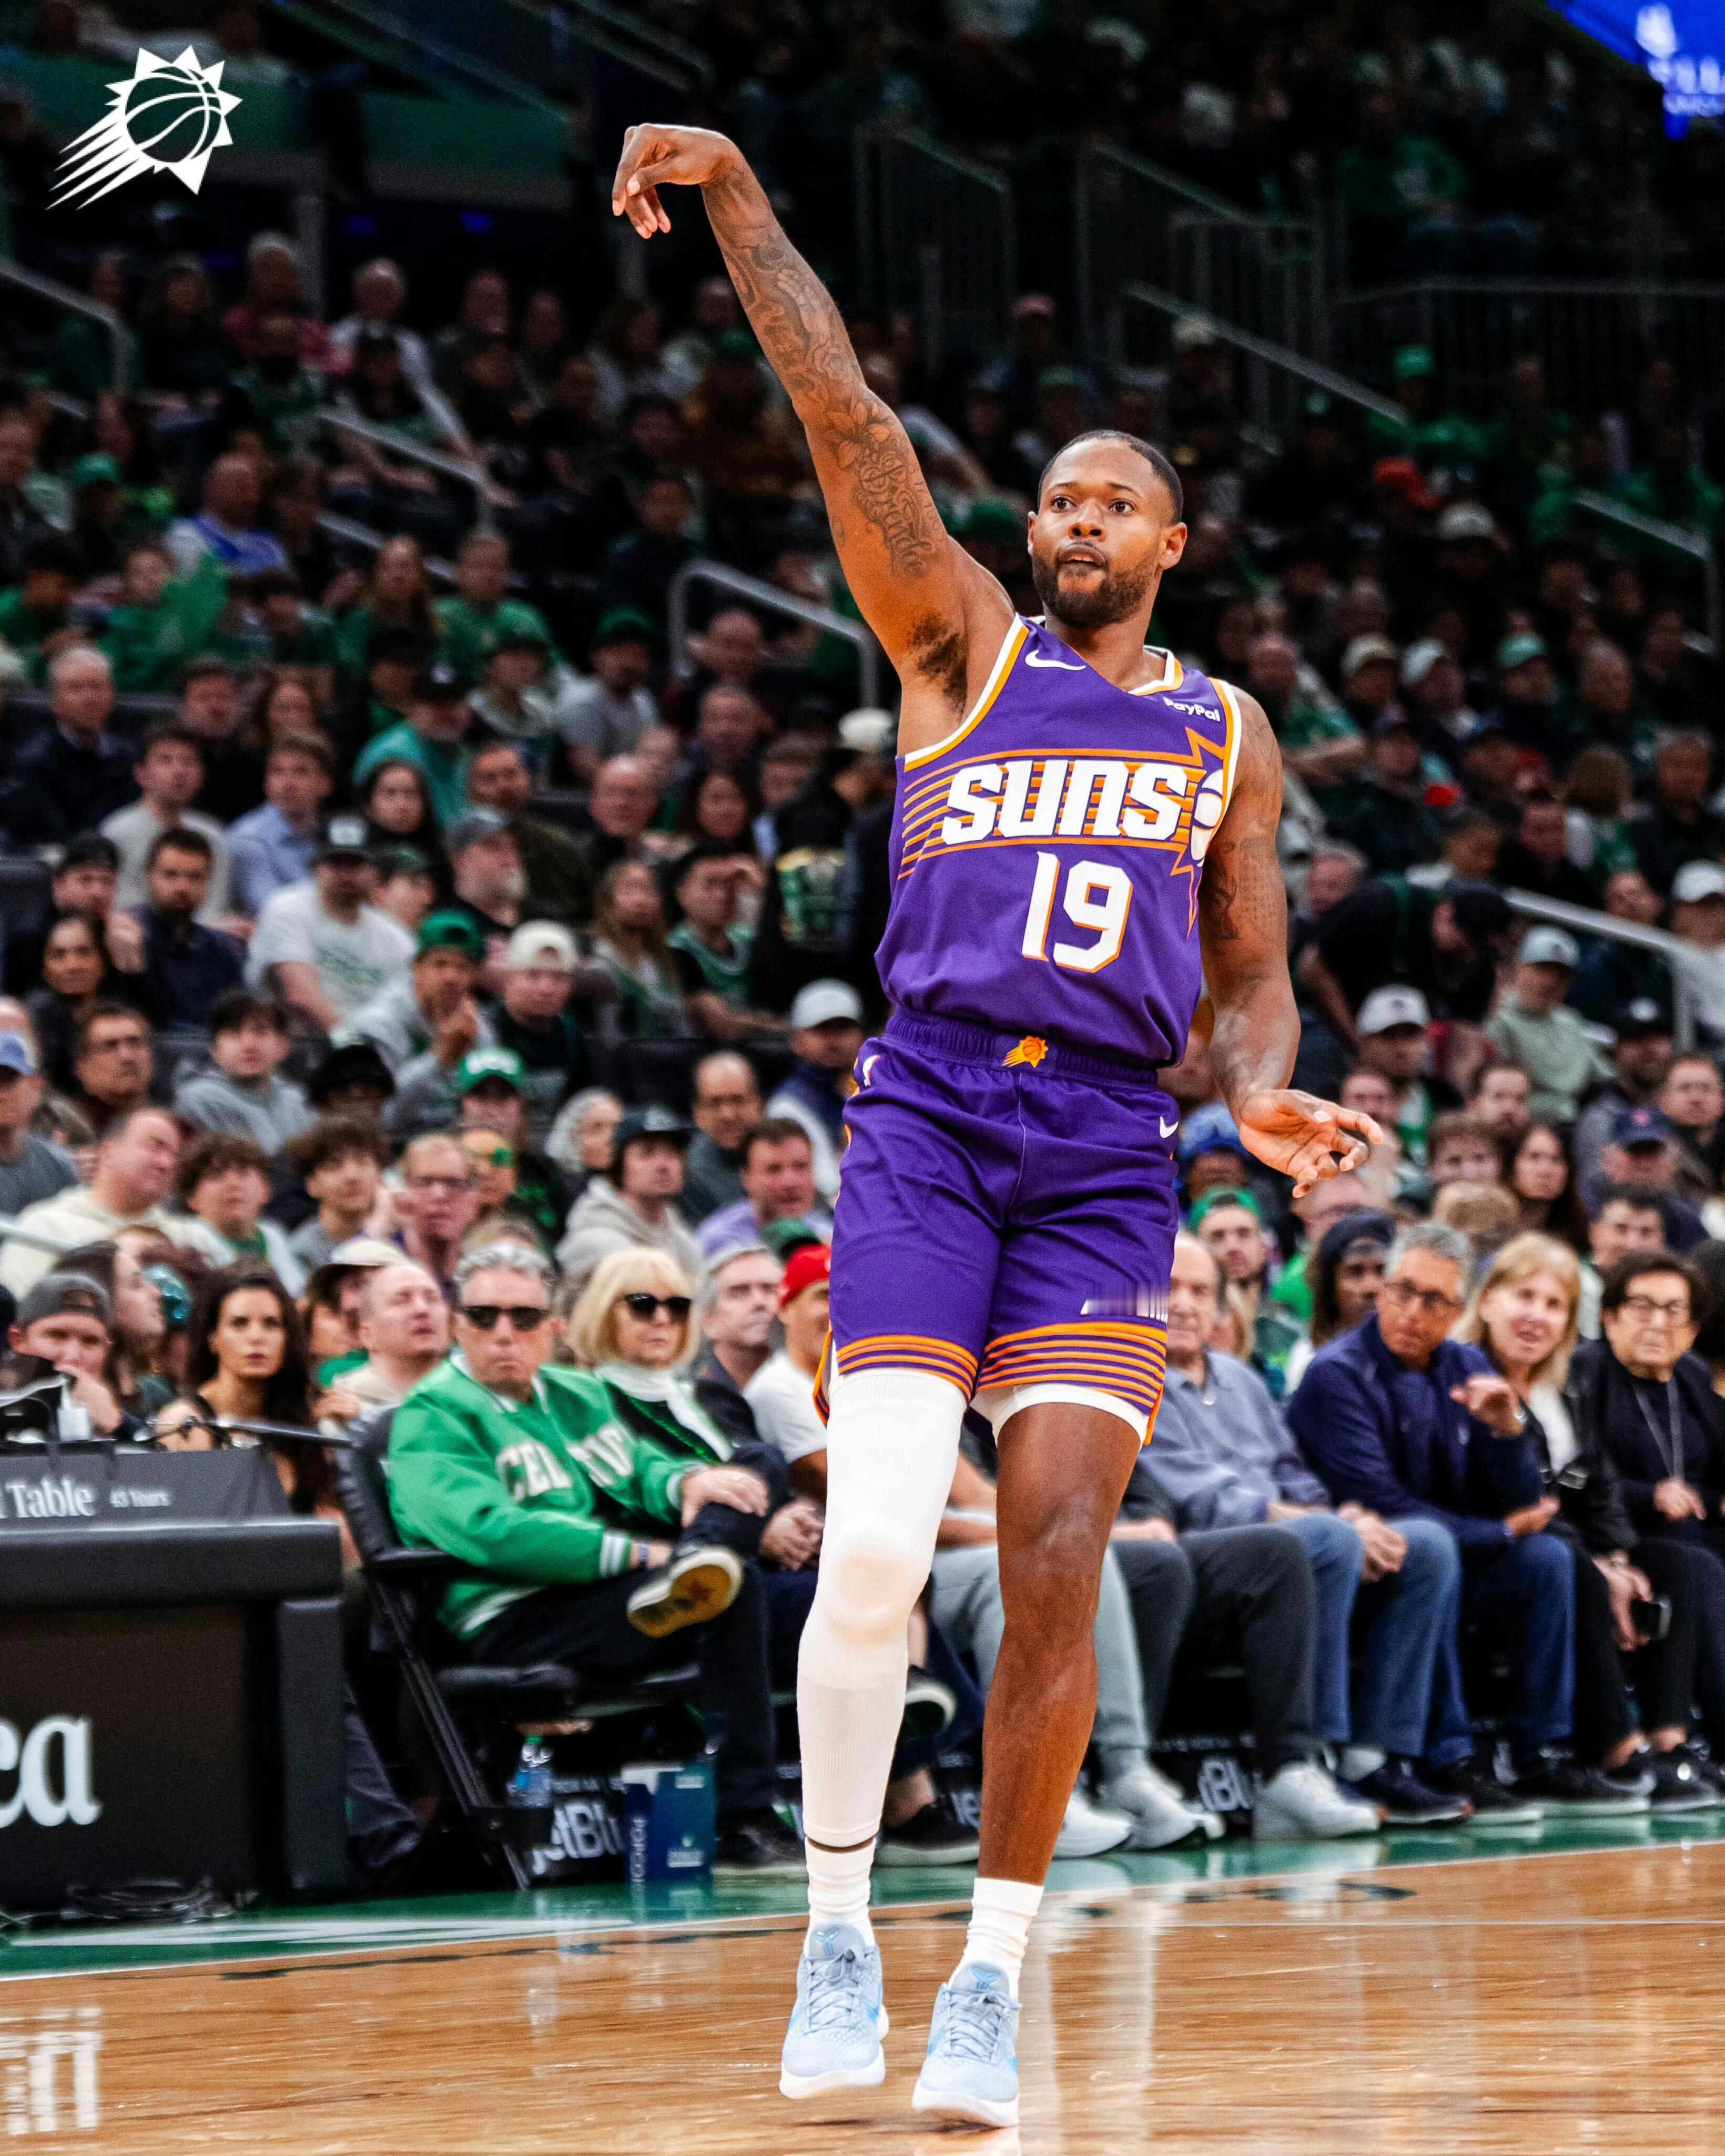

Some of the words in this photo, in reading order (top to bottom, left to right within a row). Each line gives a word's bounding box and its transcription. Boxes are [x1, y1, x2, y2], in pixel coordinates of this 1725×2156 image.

[1163, 696, 1221, 722] PayPal
[1022, 851, 1133, 973] 19
[5, 1476, 94, 1518] Table
